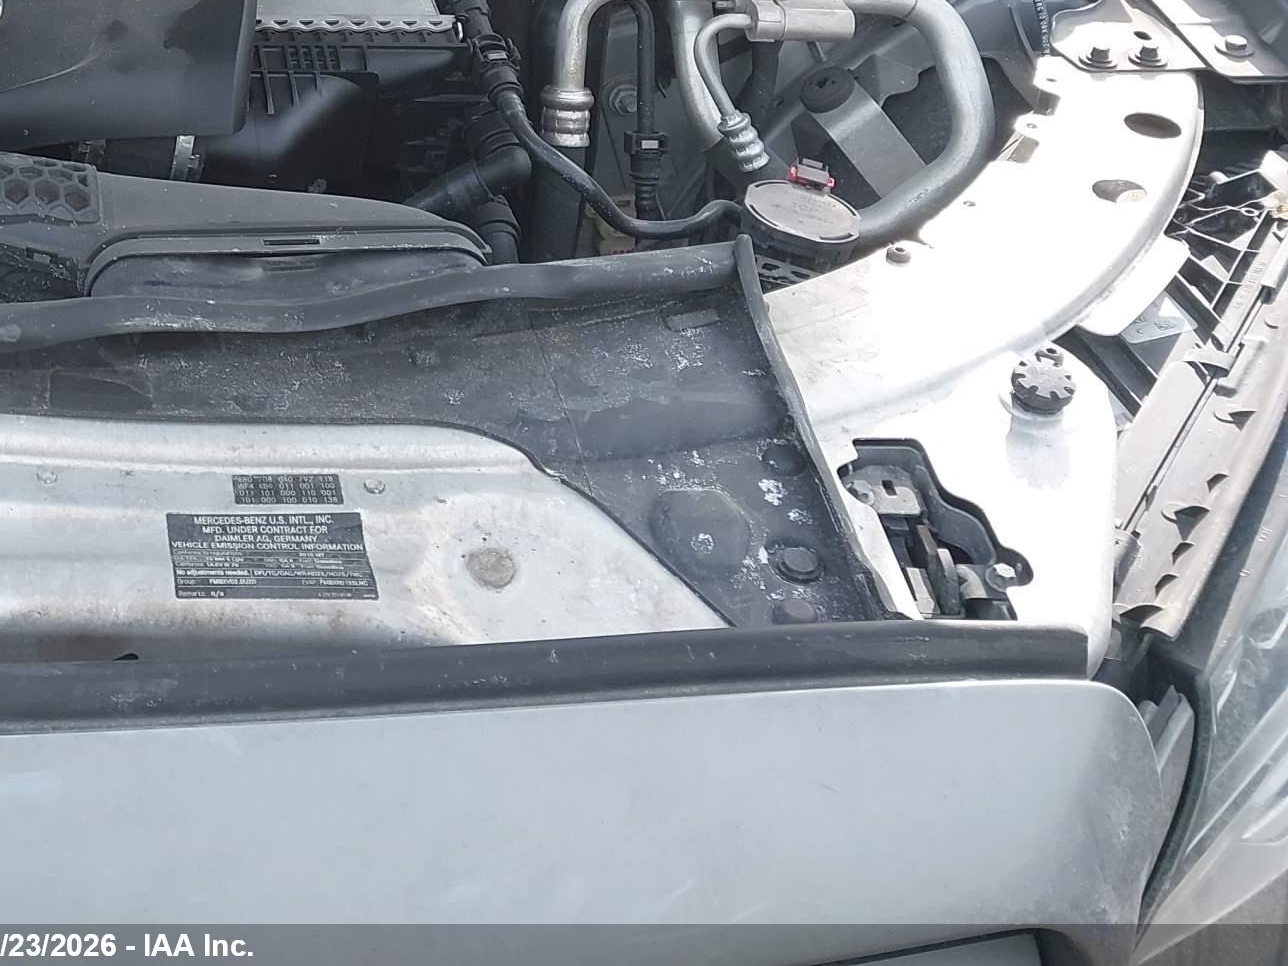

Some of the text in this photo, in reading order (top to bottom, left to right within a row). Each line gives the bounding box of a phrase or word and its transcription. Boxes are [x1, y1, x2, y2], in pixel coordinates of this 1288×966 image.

[194, 516, 267, 525] MERCEDES-BENZ
[270, 516, 287, 525] U.S.
[316, 515, 334, 524] INC.
[202, 526, 328, 534] MFD. UNDER CONTRACT FOR
[172, 542, 364, 551] VEHICLE EMISSION CONTROL INFORMATION
